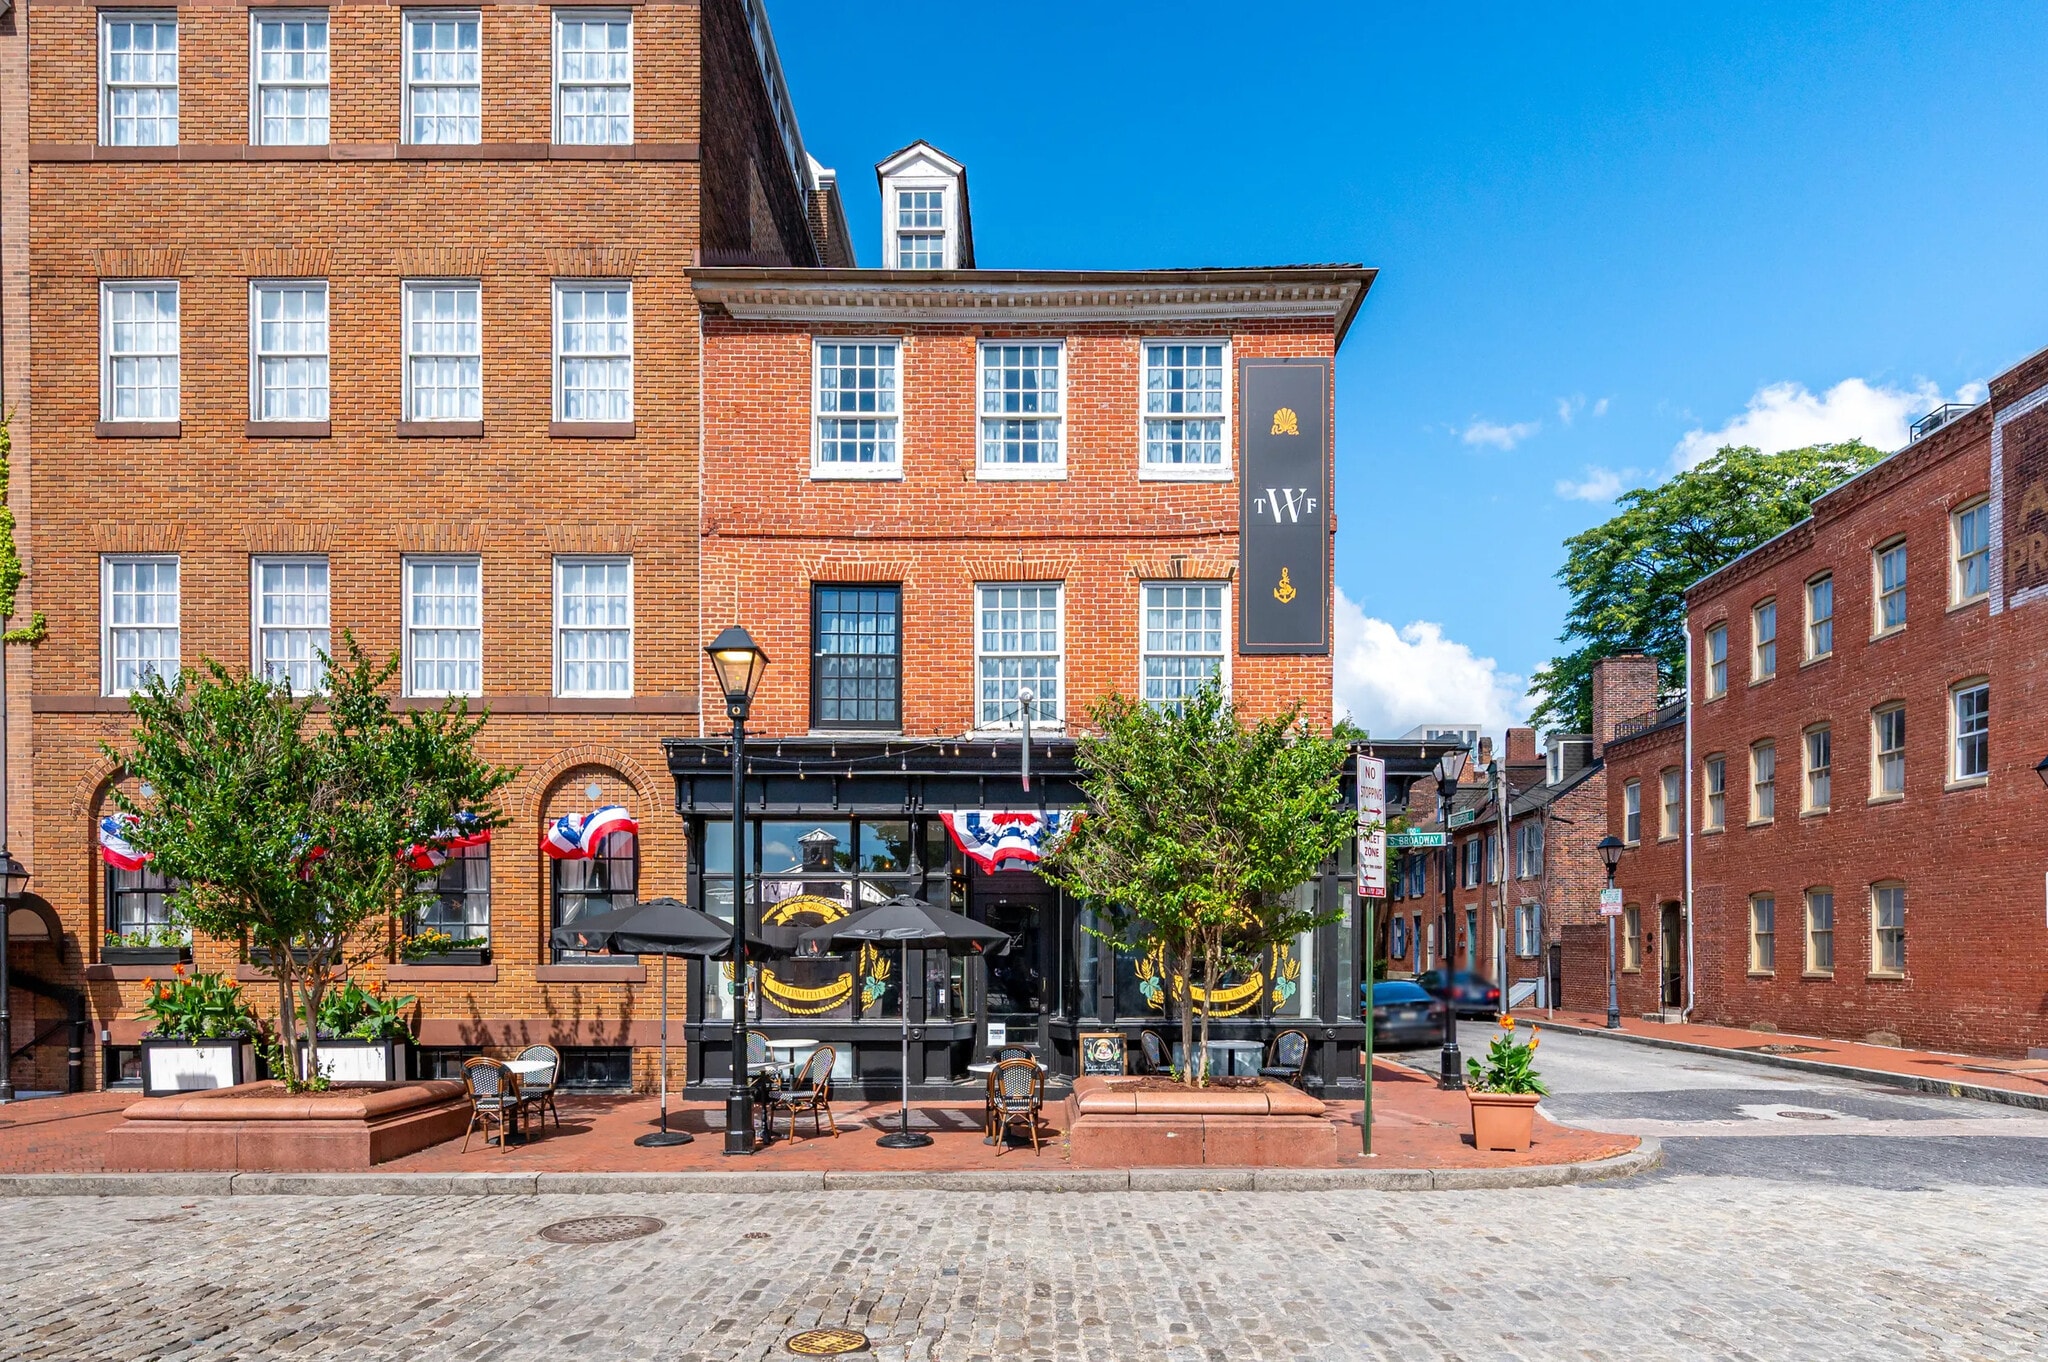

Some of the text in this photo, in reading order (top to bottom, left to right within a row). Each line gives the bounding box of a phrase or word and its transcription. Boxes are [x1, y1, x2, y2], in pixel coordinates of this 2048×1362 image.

[1365, 766, 1376, 780] NO
[1360, 785, 1382, 801] STOPPING
[1399, 835, 1439, 846] BROADWAY
[1364, 846, 1379, 858] ZONE
